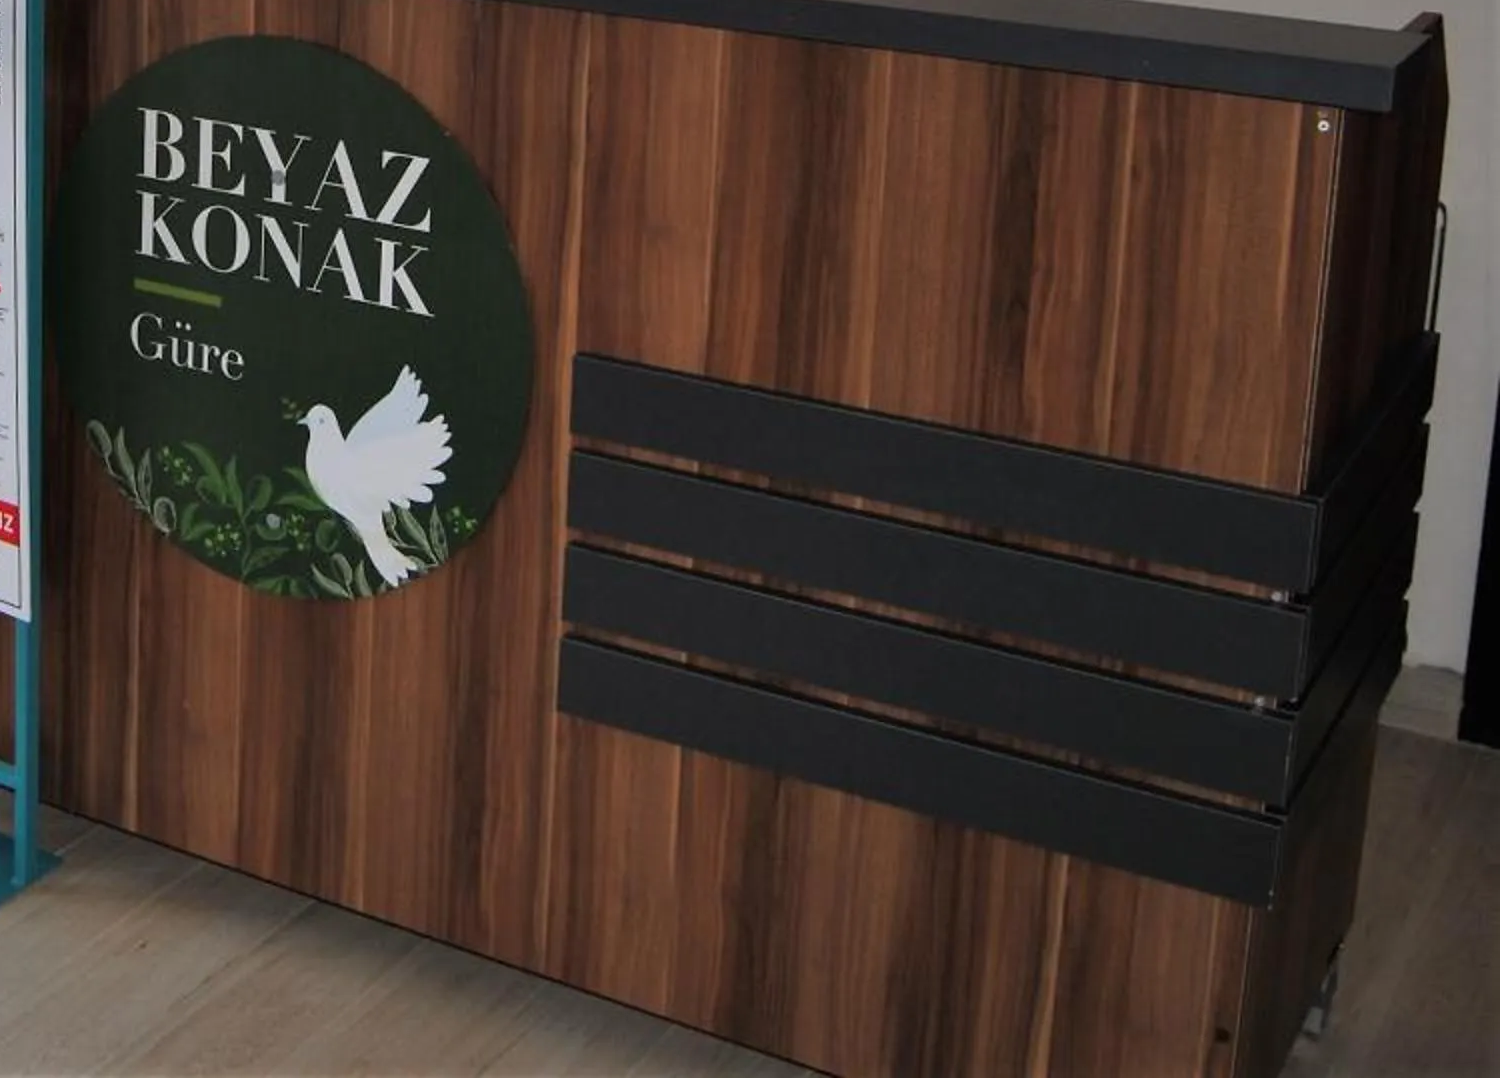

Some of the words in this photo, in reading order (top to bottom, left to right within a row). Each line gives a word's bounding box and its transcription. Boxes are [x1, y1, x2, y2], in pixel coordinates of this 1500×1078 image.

[137, 107, 432, 232] BEYAZ
[135, 189, 435, 318] KONAK
[130, 312, 245, 381] Güre
